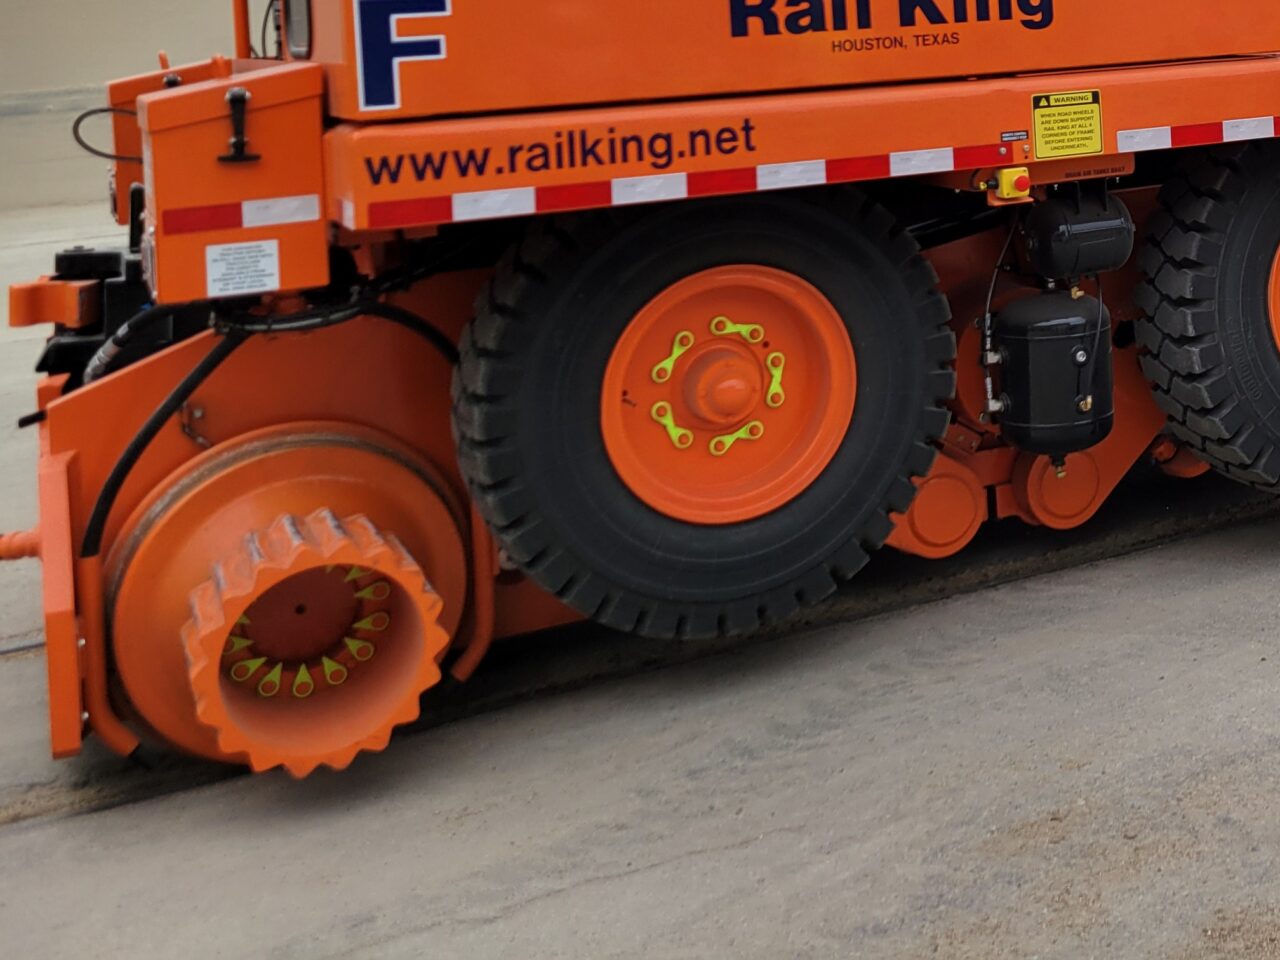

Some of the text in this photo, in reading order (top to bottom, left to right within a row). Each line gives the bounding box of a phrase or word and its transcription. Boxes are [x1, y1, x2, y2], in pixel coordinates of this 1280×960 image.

[831, 32, 960, 52] HOUSTON, TEXAS
[1054, 95, 1089, 103] WARNING
[364, 117, 757, 186] www.railking.net
